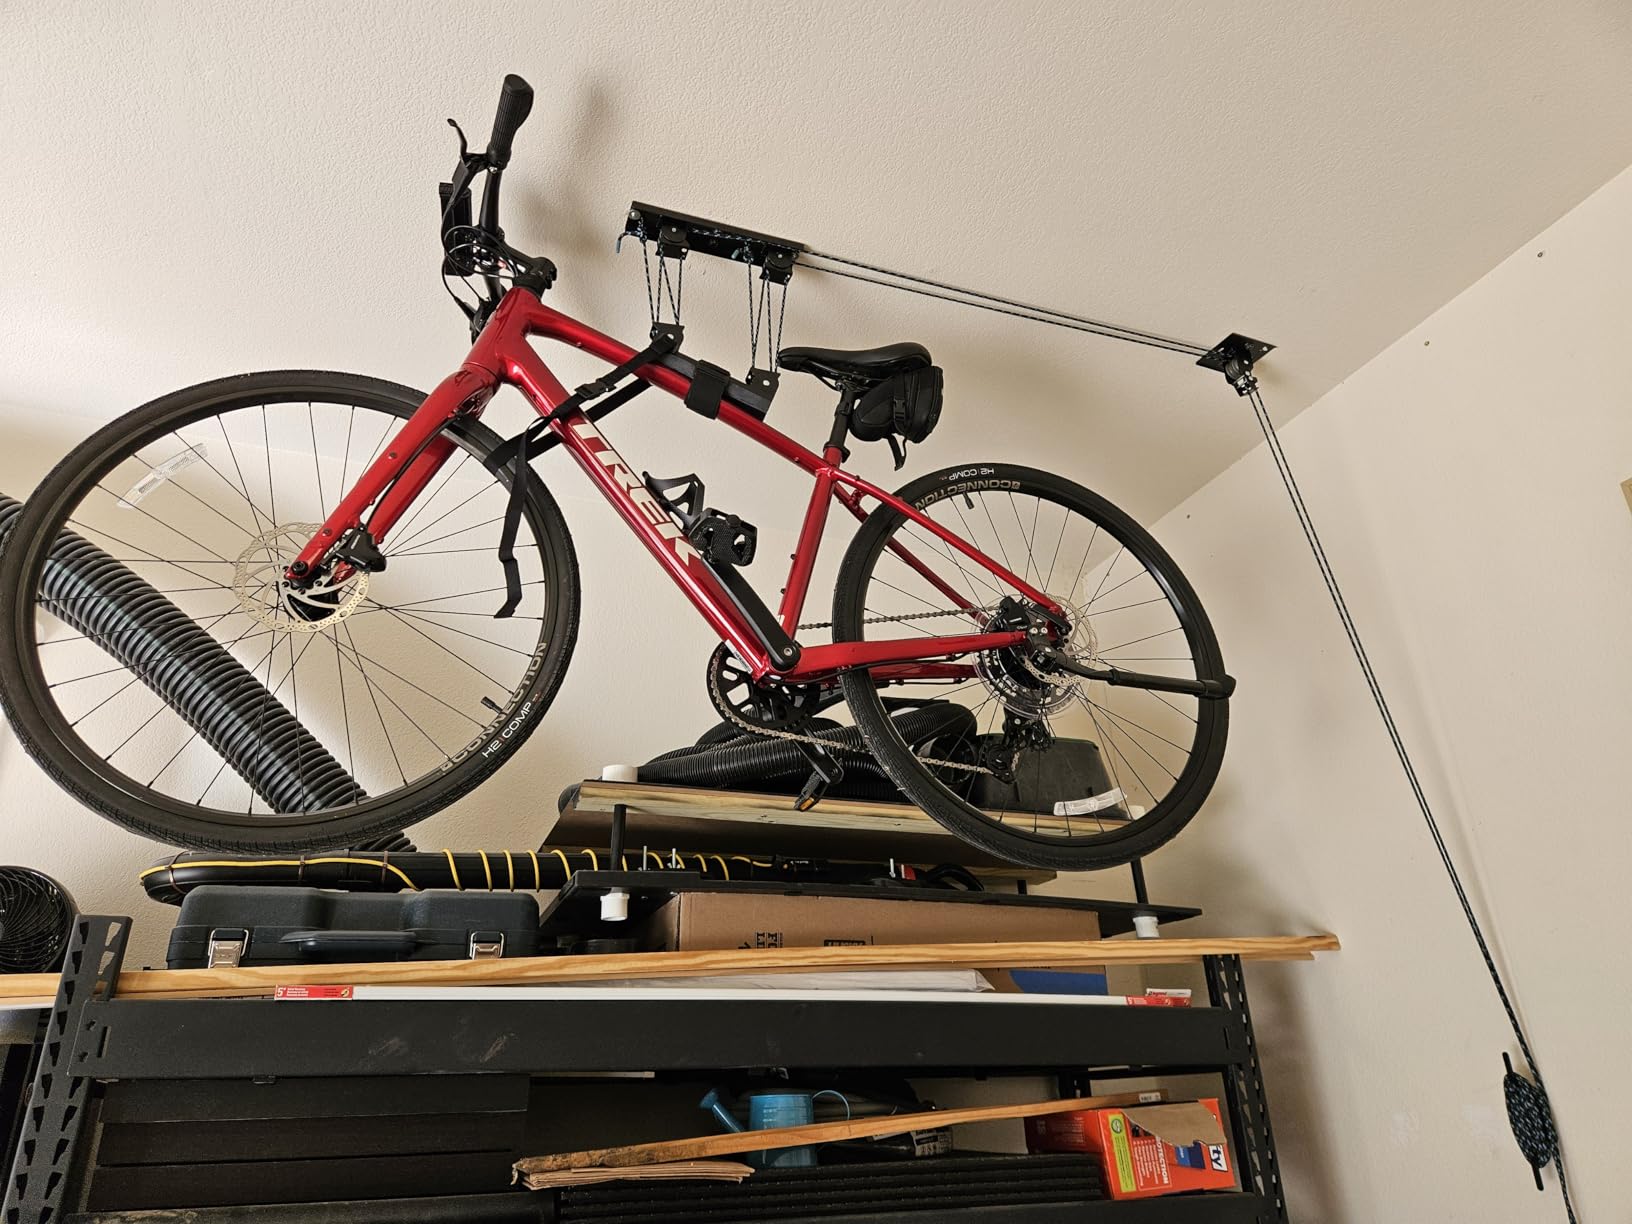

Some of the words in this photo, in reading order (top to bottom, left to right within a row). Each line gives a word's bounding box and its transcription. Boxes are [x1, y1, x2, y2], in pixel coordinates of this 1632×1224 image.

[949, 468, 979, 481] COMP
[980, 467, 995, 475] H2
[572, 423, 703, 567] TREK
[914, 479, 1012, 511] CONNECTION
[450, 642, 548, 763] CONNECTION
[481, 739, 502, 758] H2
[502, 701, 533, 739] COMP
